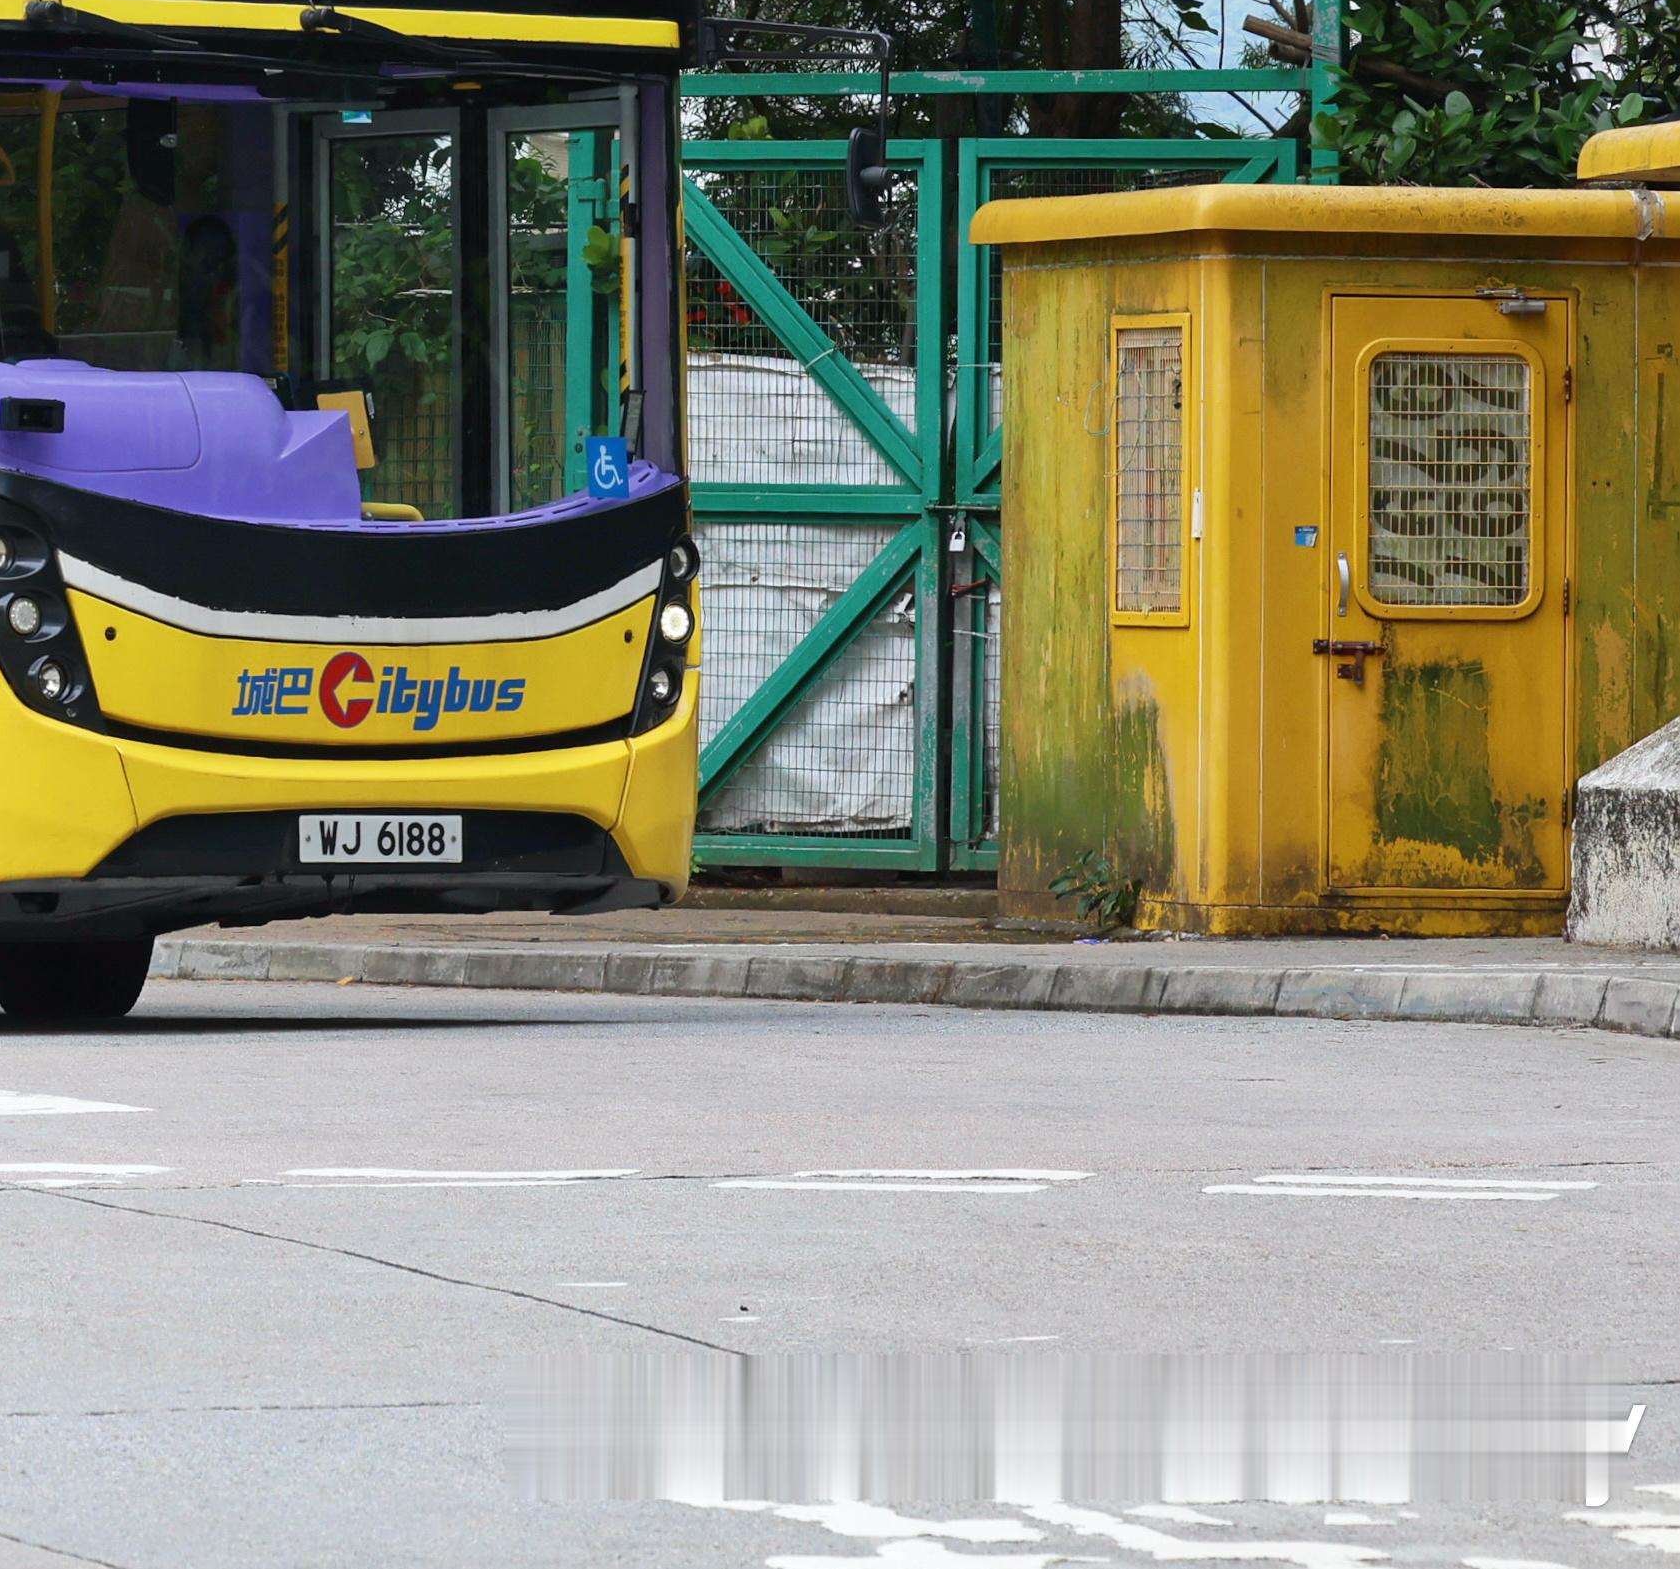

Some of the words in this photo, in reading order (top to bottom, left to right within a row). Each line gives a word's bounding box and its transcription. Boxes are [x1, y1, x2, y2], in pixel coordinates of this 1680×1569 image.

[231, 666, 314, 716] 城巴
[318, 651, 527, 731] Citybus
[319, 820, 361, 856] WJ
[377, 821, 445, 856] 6188
